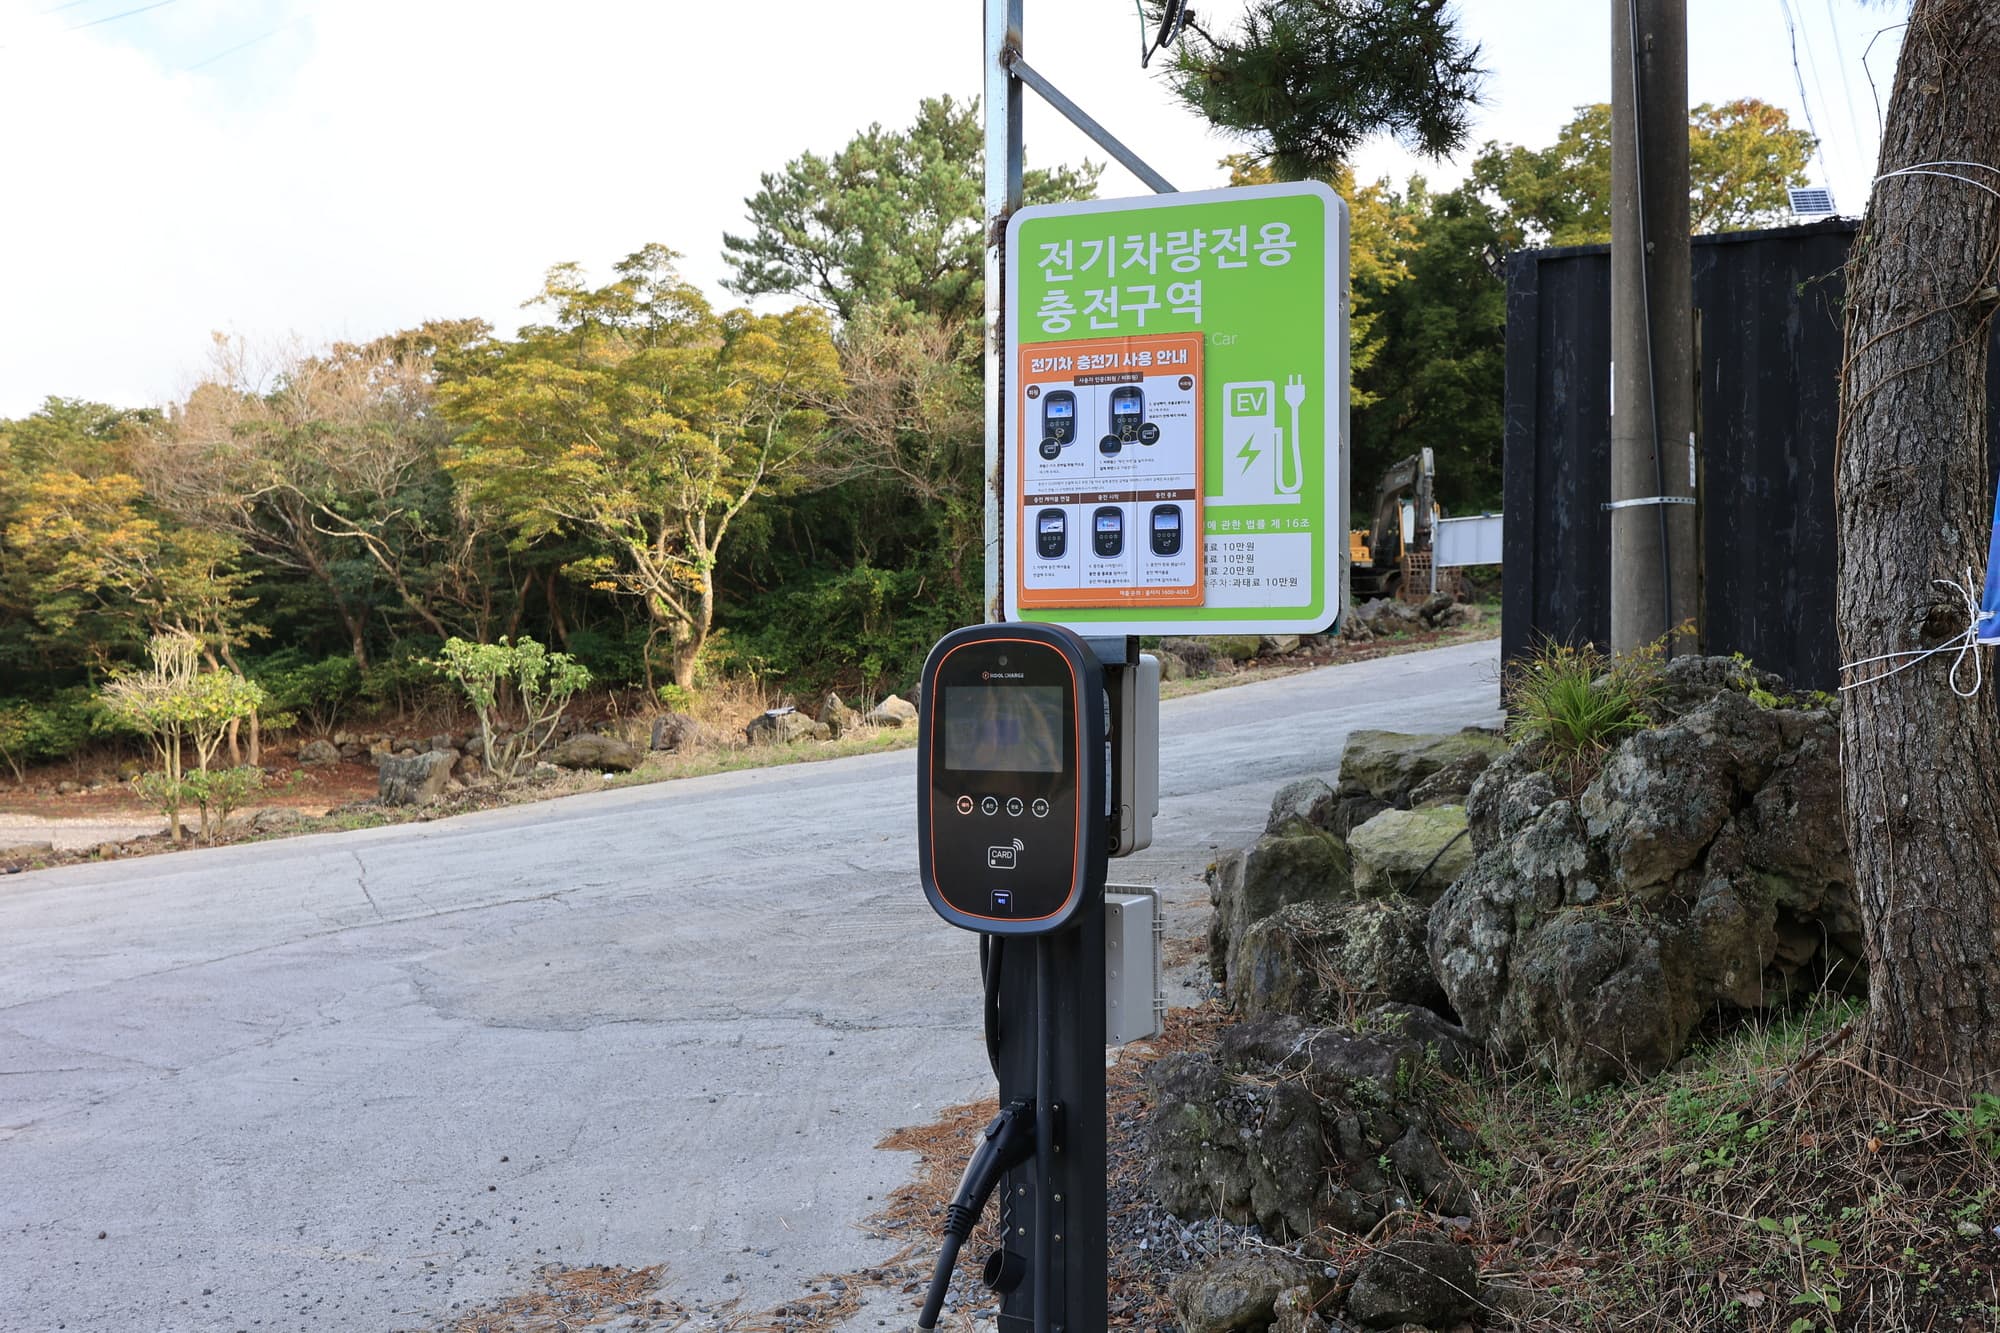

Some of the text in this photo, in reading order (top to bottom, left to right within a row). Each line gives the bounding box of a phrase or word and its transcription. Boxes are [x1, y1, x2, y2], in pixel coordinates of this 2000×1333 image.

[1038, 222, 1296, 282] 전기차량전용
[1037, 279, 1202, 334] 충전구역
[1212, 332, 1238, 346] Car
[1031, 349, 1188, 373] 전기차 충전기 사용 안내
[1237, 392, 1265, 412] EV
[1222, 519, 1241, 531] 관한
[1246, 519, 1266, 530] 법률
[1271, 518, 1281, 529] 제
[1285, 518, 1310, 529] 16조
[1223, 541, 1255, 552] 10만원
[1223, 553, 1255, 564] 10만원
[1223, 565, 1255, 576] 20만원
[1265, 576, 1298, 588] 10만원
[991, 850, 1013, 859] CARD
